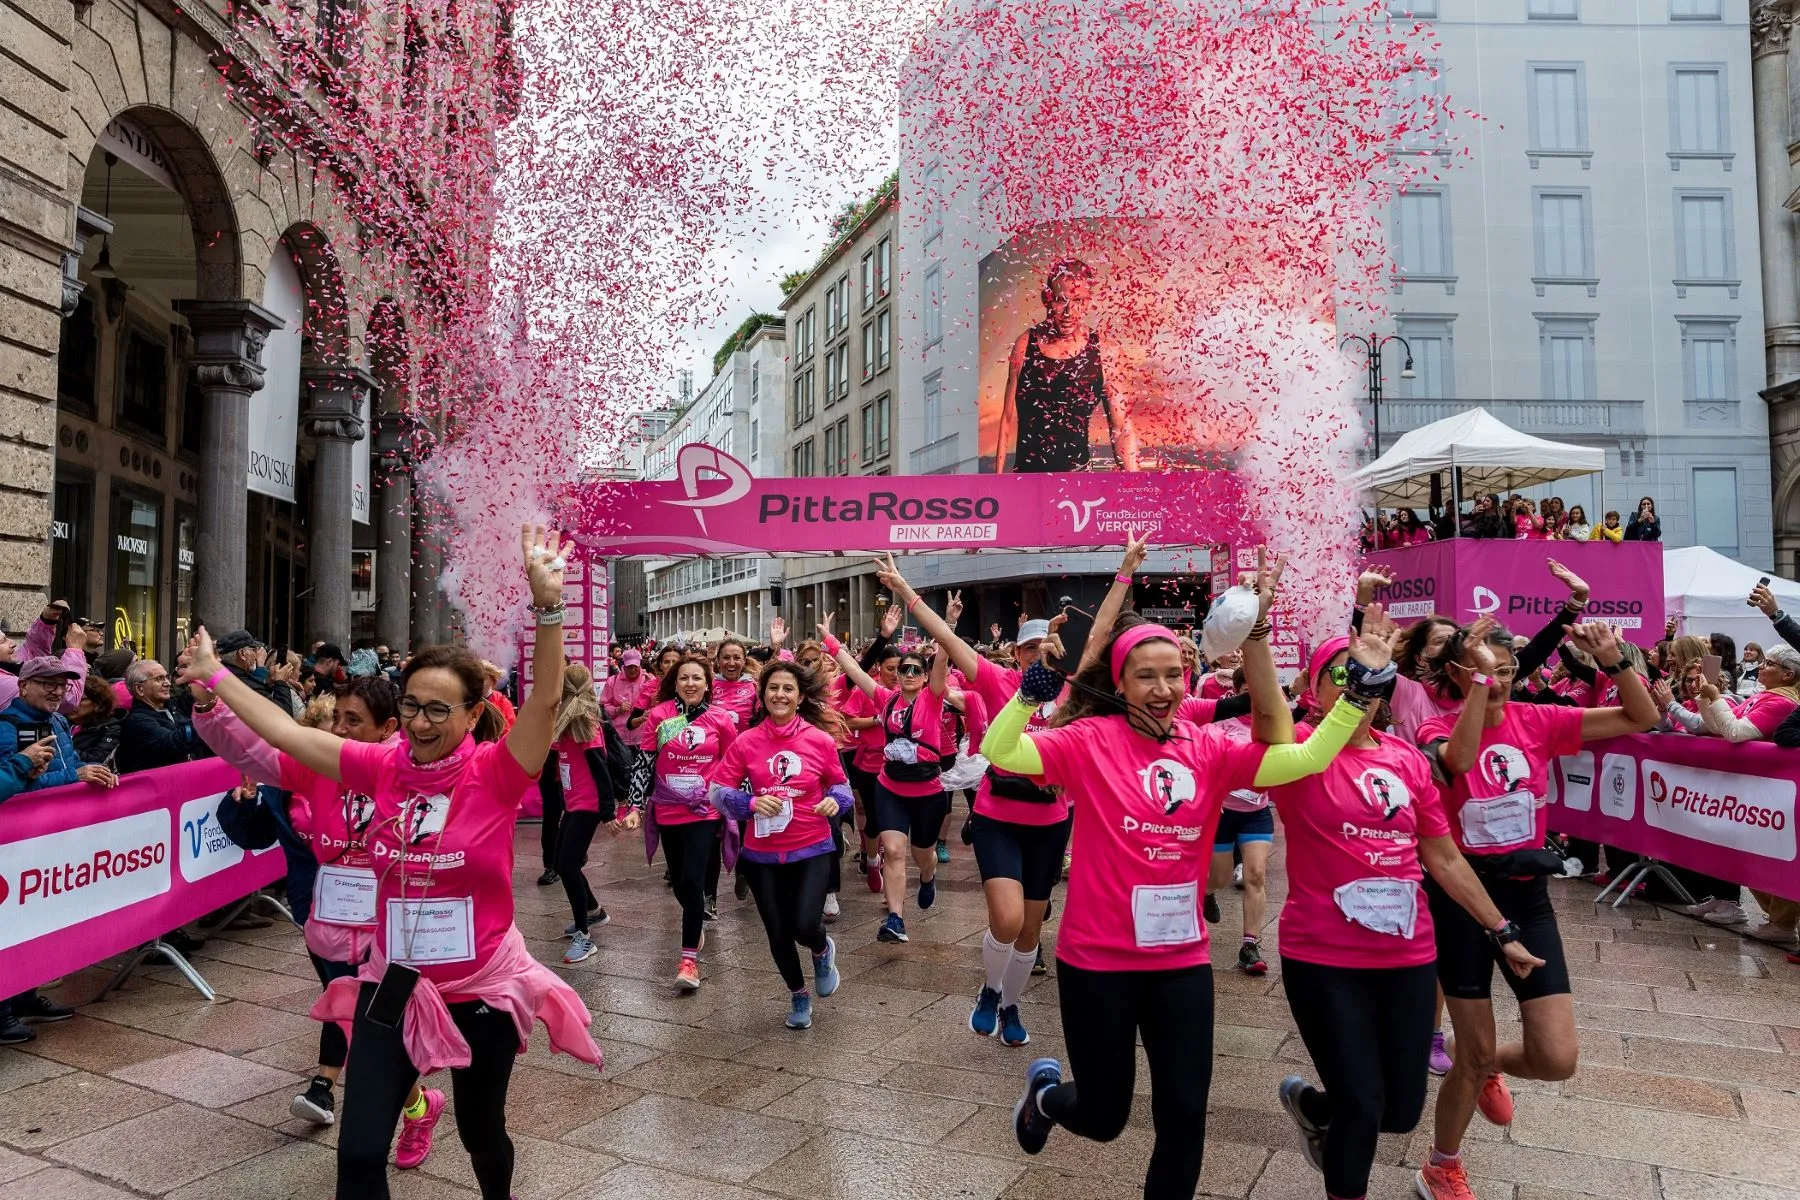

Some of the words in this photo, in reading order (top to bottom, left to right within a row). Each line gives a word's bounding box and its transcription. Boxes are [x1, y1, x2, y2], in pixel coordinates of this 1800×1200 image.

[247, 450, 295, 488] ROVSKI
[758, 491, 1000, 524] PittaRosso
[1096, 508, 1163, 519] Fondazione
[896, 527, 931, 540] PINK
[936, 525, 992, 539] PARADE
[1096, 520, 1162, 532] VERONESI
[1507, 595, 1643, 615] Pittaosso
[1671, 785, 1786, 831] PittaRosso
[19, 842, 165, 905] PittaRosso
